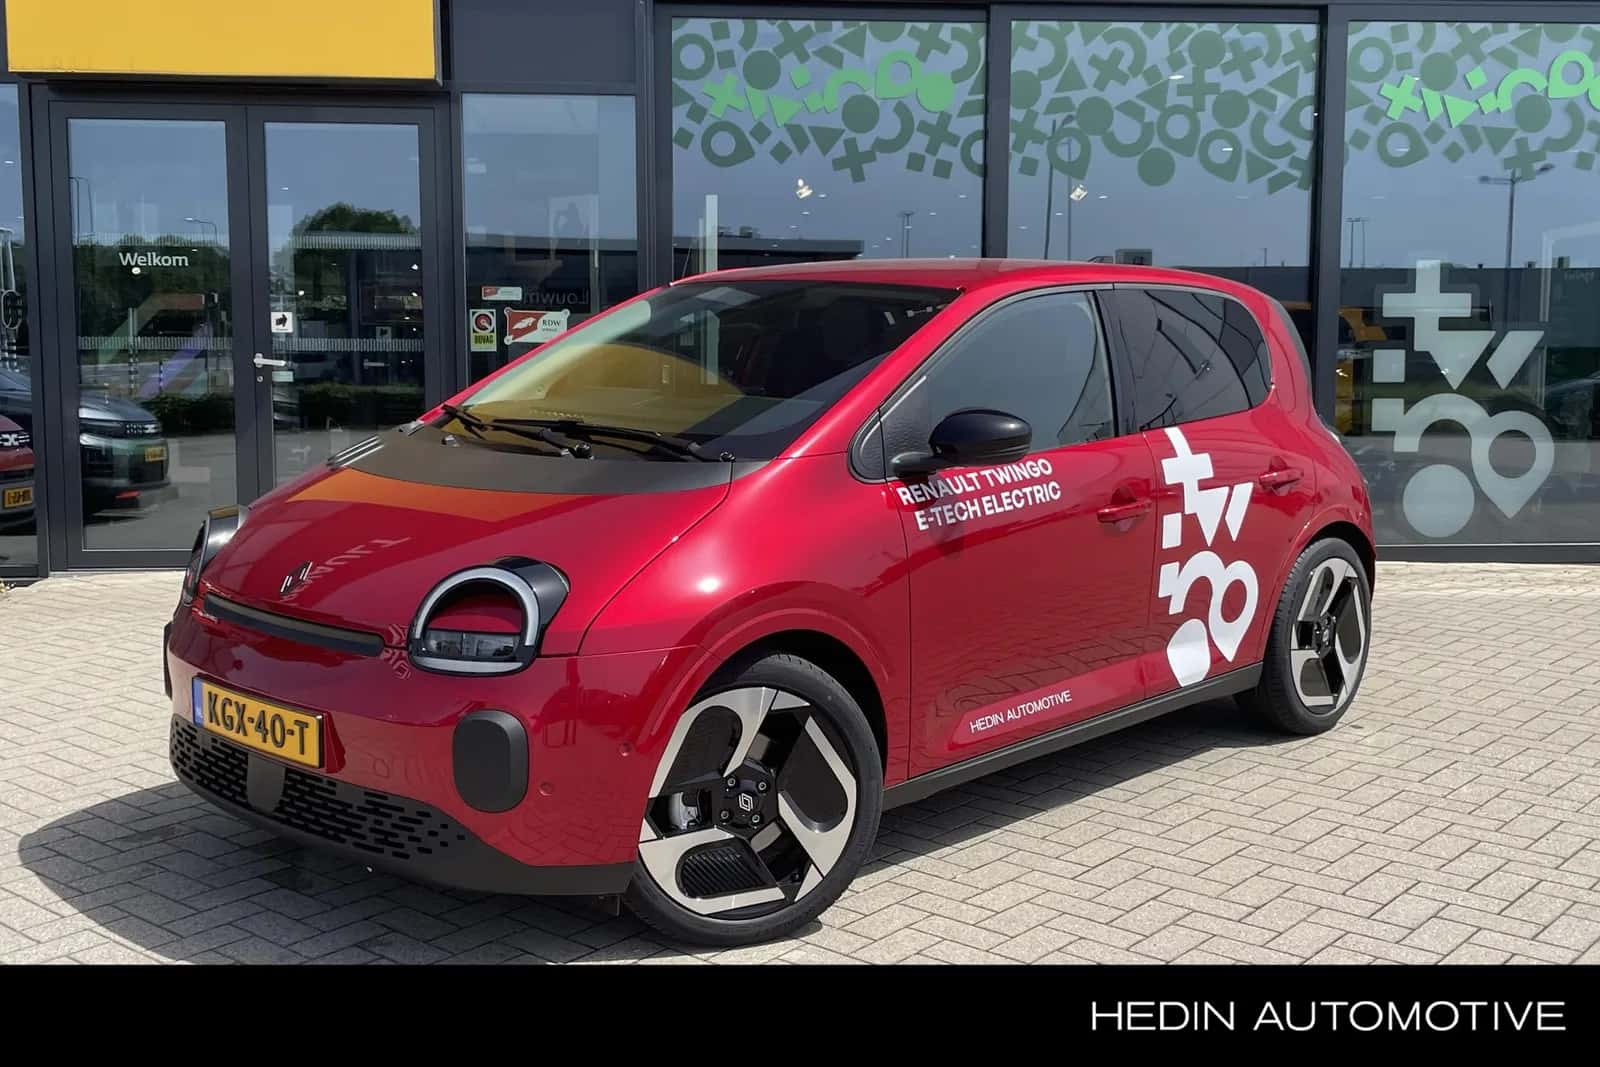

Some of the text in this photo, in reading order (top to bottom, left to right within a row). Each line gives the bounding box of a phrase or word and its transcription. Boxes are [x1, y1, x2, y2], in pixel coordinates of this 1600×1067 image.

[119, 251, 189, 267] Welkom
[897, 458, 1053, 506] RENAULT TWINGO
[914, 481, 1062, 532] E-TECH ELECTRIC
[207, 691, 310, 756] KGX-40-T
[969, 689, 1073, 734] HEDIN AUTOMOTIVE
